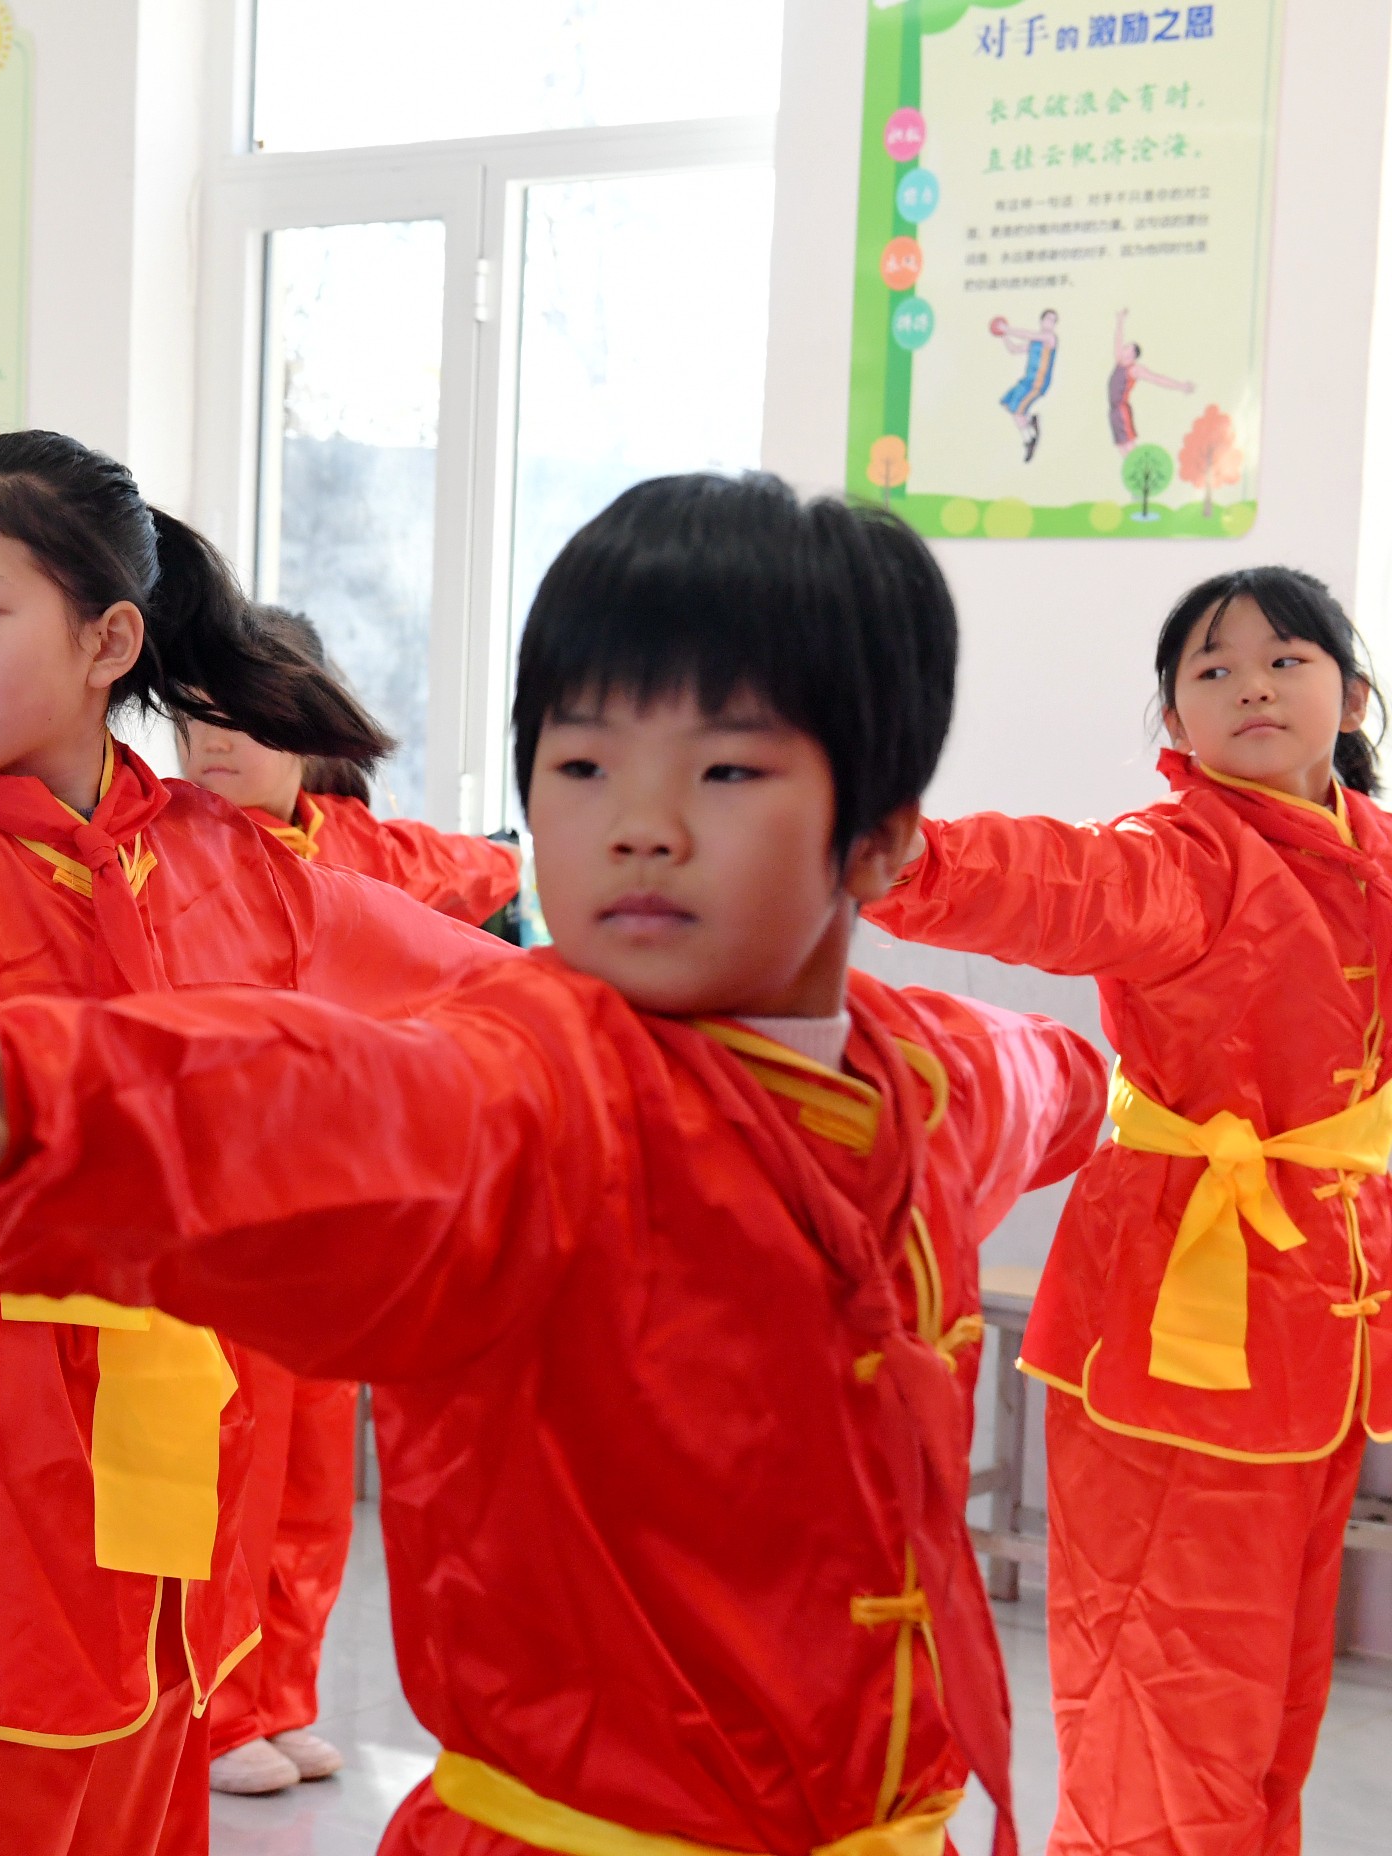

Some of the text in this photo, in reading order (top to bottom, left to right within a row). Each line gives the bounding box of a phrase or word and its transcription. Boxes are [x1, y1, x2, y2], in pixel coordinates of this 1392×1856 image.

[975, 5, 1214, 58] 对手的激励之恩
